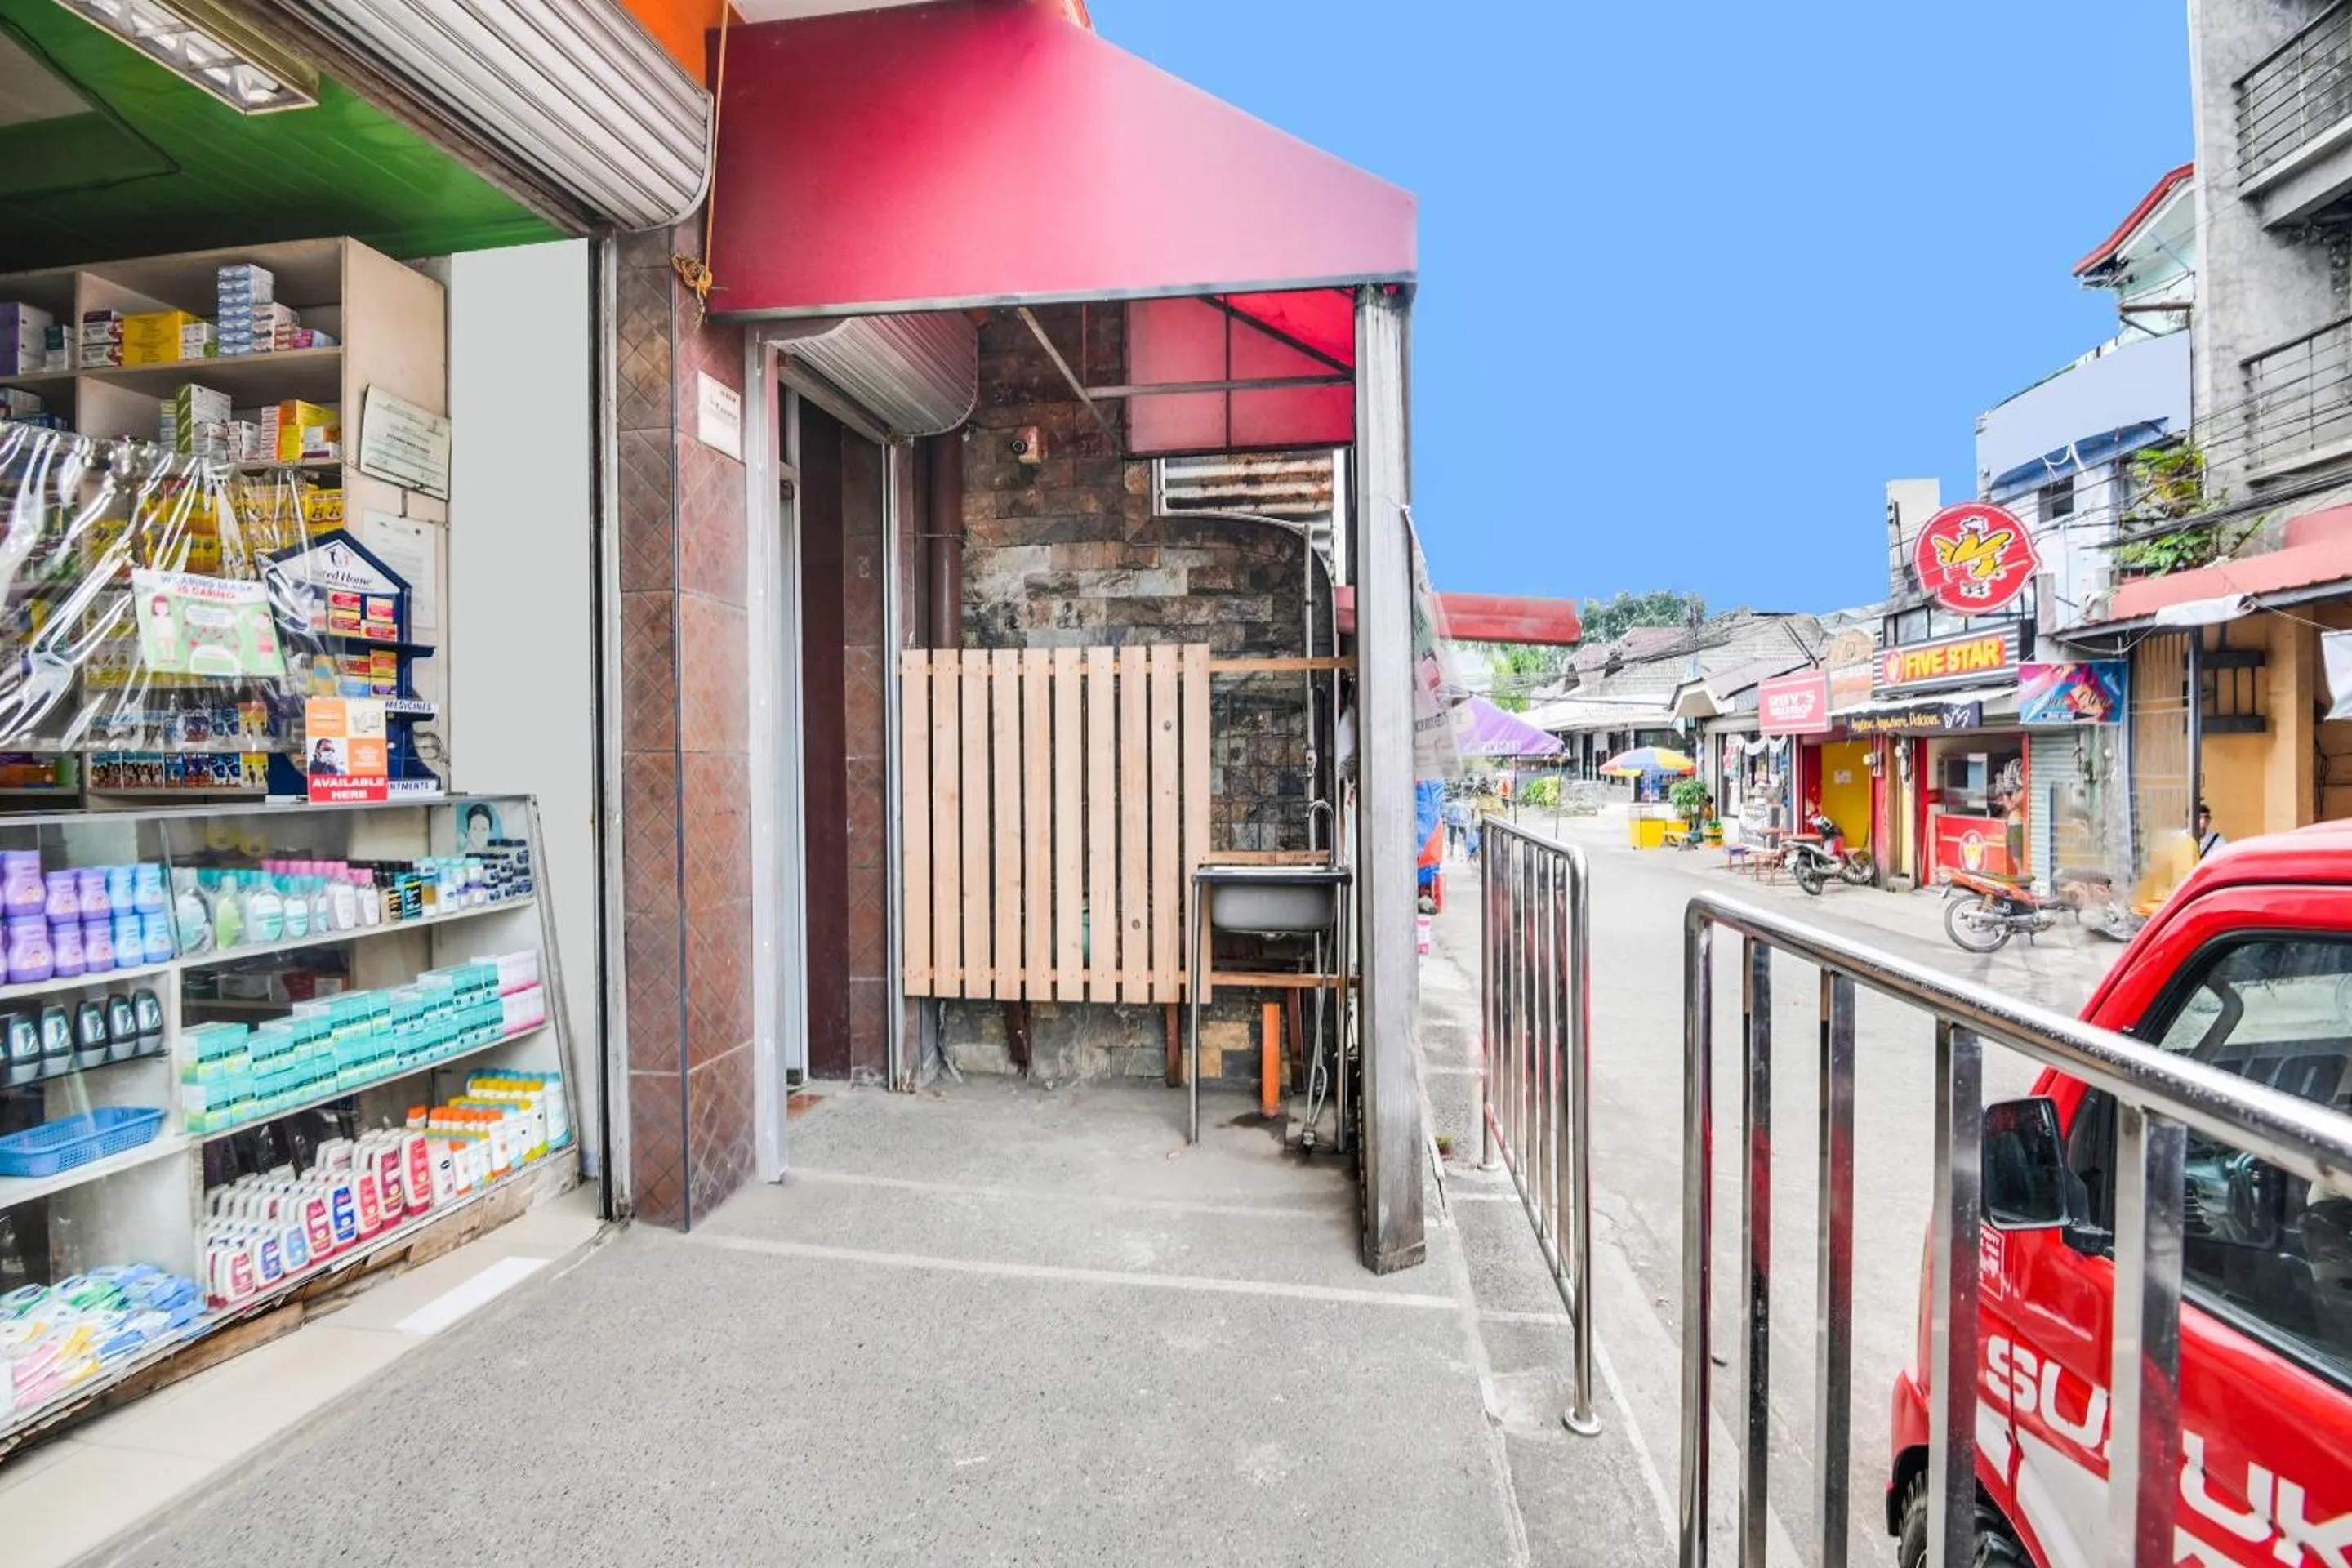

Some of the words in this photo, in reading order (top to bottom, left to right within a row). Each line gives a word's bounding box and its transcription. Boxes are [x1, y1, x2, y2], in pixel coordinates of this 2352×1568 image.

[1905, 647, 1947, 679] FIVE
[1947, 639, 1999, 673] STAR
[313, 777, 385, 788] AVAILABLE
[331, 790, 368, 800] HERE
